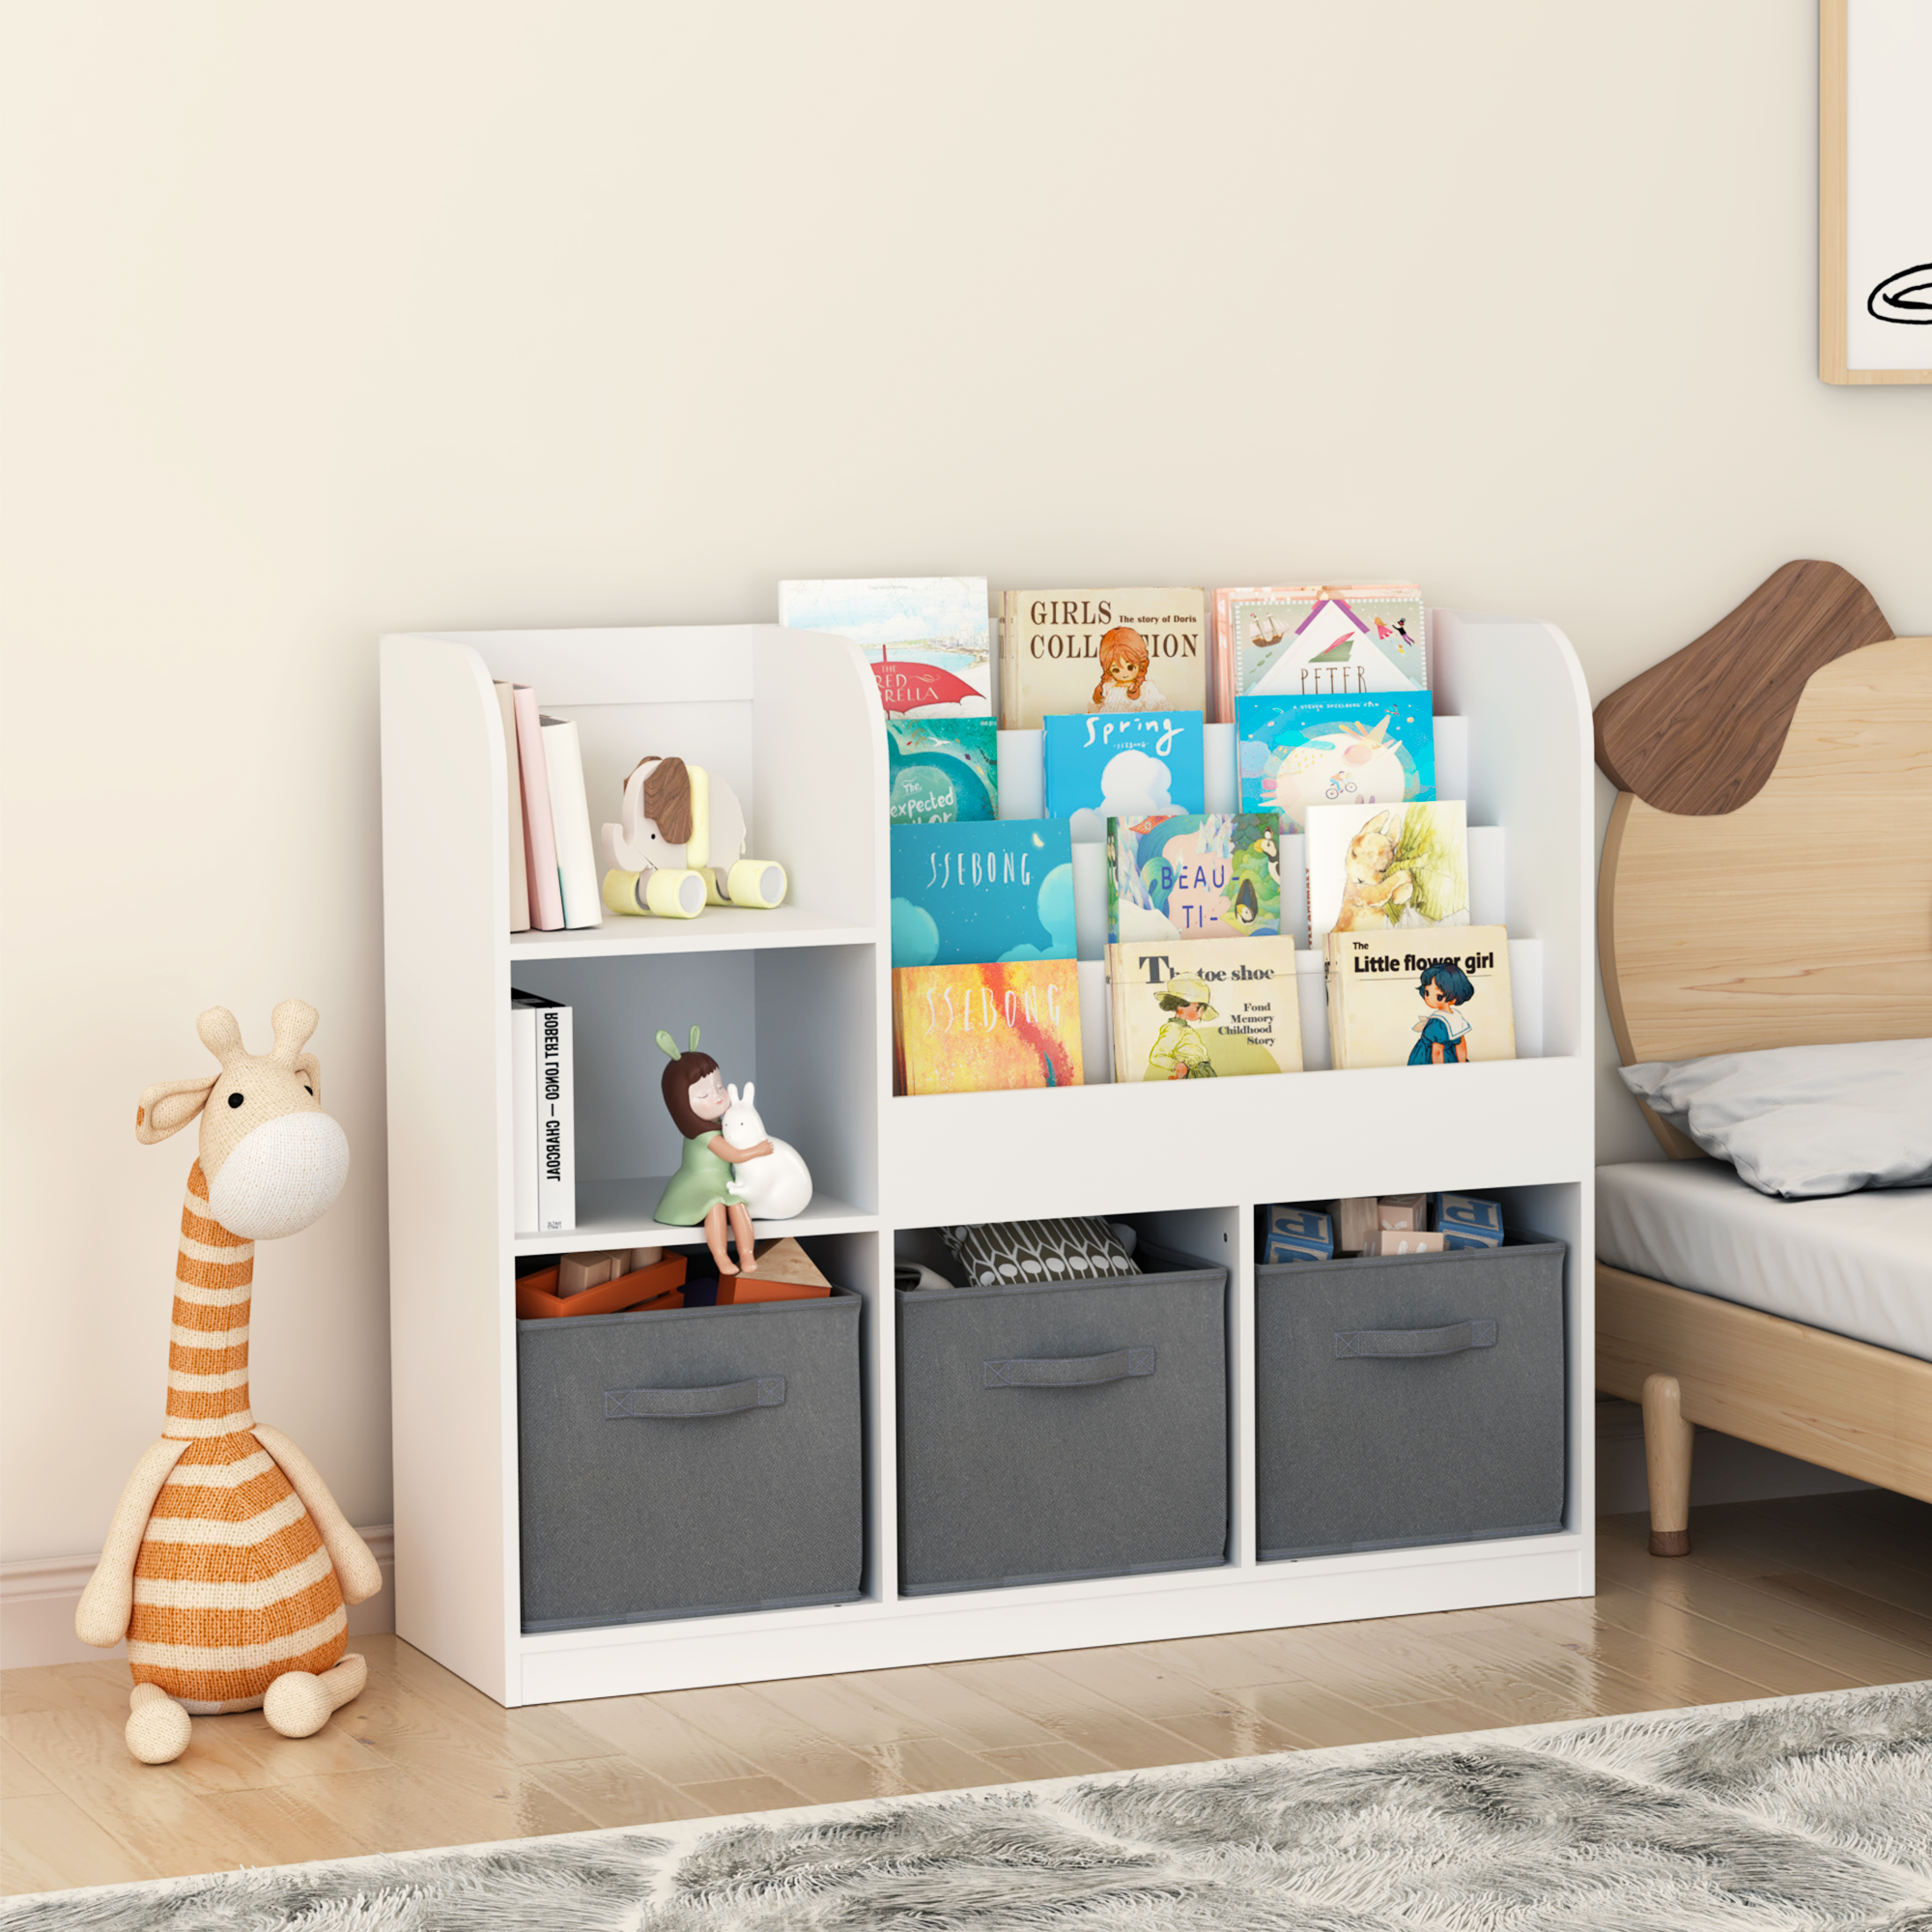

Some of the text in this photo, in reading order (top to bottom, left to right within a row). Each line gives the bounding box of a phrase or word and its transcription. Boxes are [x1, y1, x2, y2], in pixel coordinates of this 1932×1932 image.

[1030, 600, 1112, 625] GIRLS
[1137, 615, 1159, 625] story
[1161, 614, 1171, 623] of
[1173, 614, 1197, 623] Doris
[881, 665, 897, 673] THE
[880, 687, 939, 702] RELLA
[1083, 717, 1184, 756] Spring
[926, 852, 1031, 889] SSEBONG
[1352, 942, 1369, 951] The
[1354, 952, 1494, 975] Little flower girl
[1197, 968, 1227, 982] toe
[1231, 964, 1275, 981] shoe
[926, 983, 1062, 1035] SSEBONG
[1243, 1003, 1271, 1012] Fond
[1231, 1014, 1274, 1025] Memory
[1218, 1023, 1272, 1036] Childhood
[1247, 1037, 1275, 1047] Story
